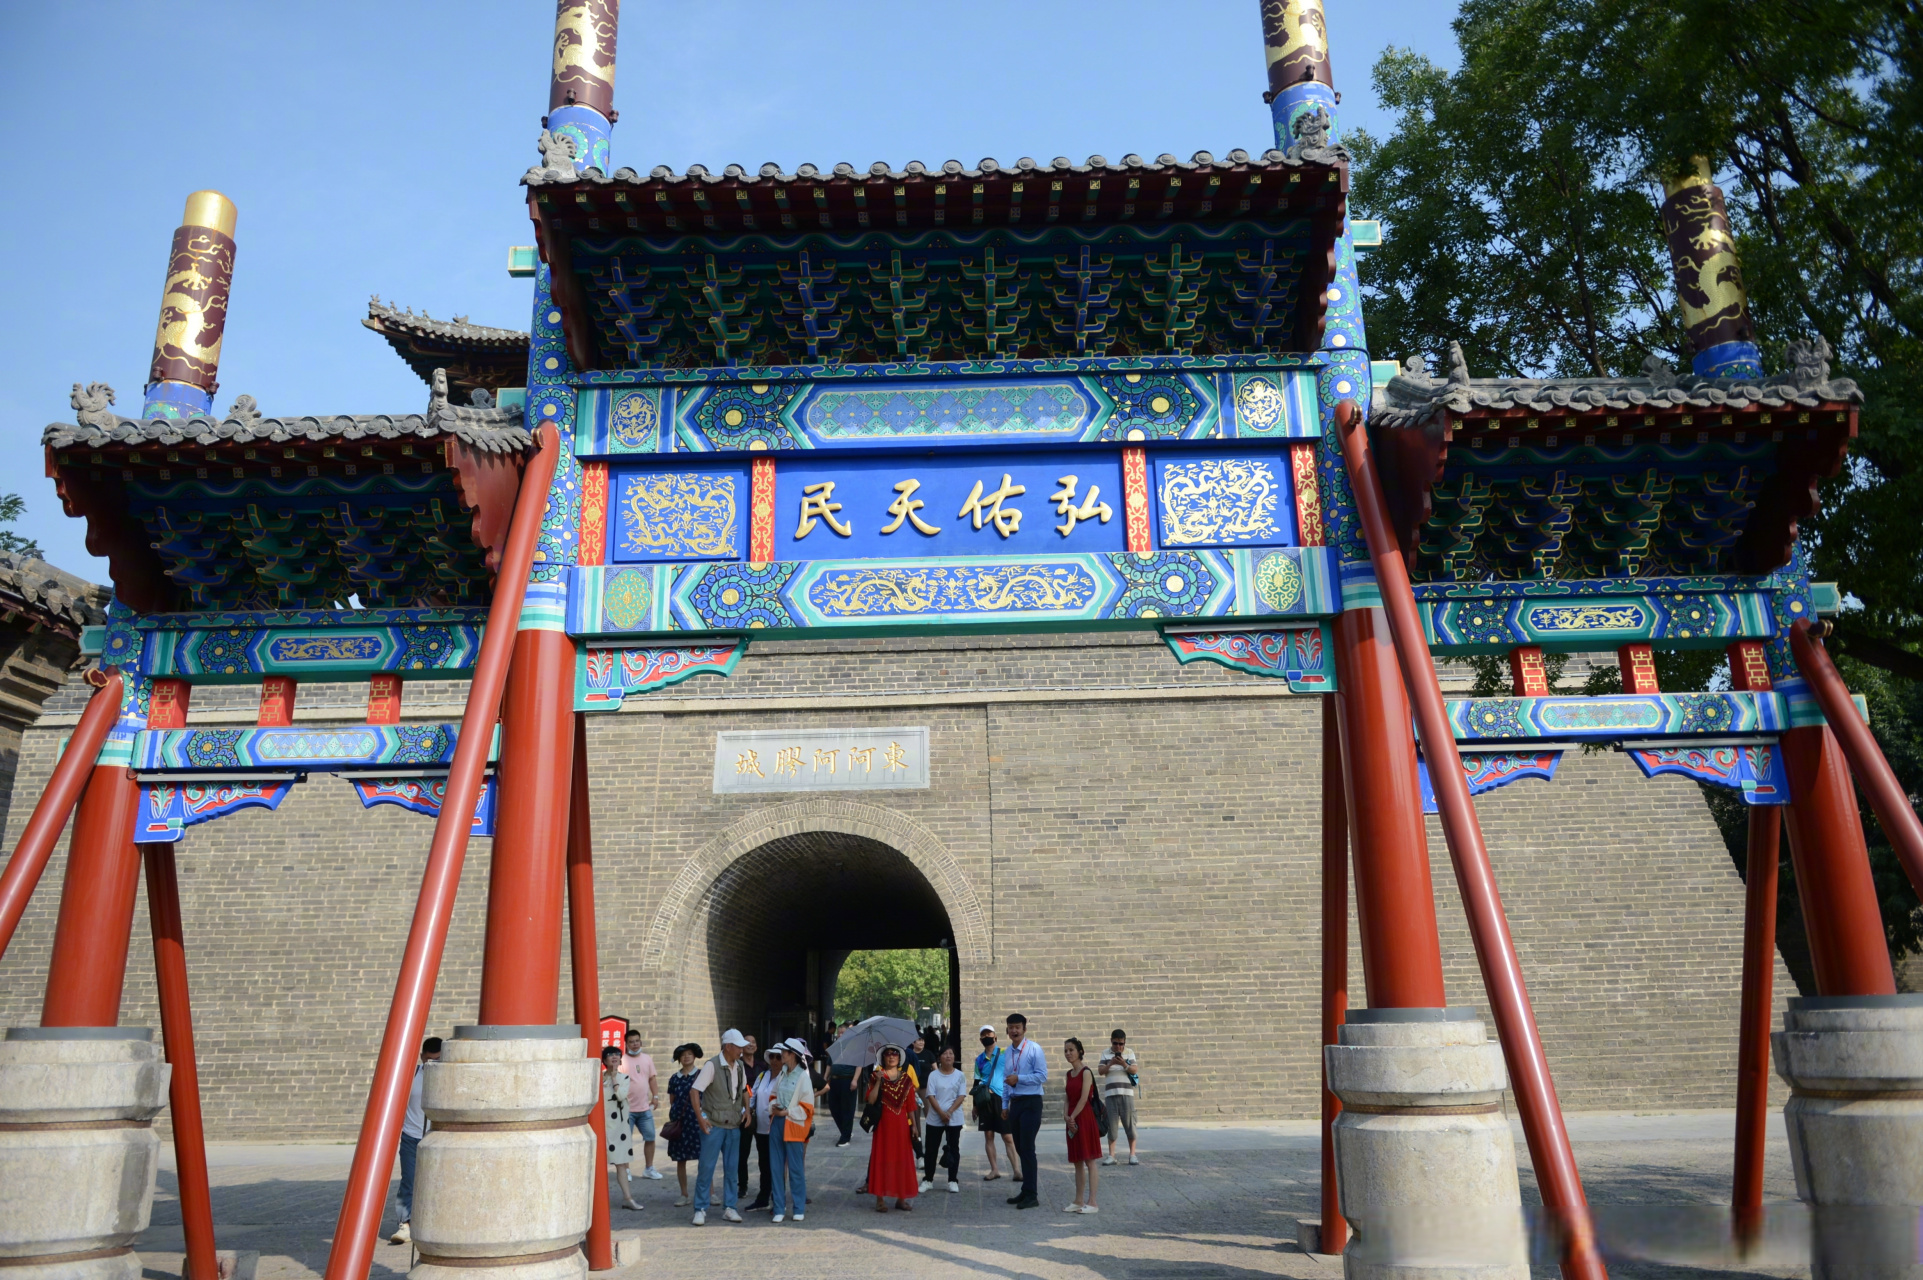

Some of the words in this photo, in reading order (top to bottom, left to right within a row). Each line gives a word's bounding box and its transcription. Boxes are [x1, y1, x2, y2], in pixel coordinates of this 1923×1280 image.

[734, 740, 909, 779] 東阿阿膠城
